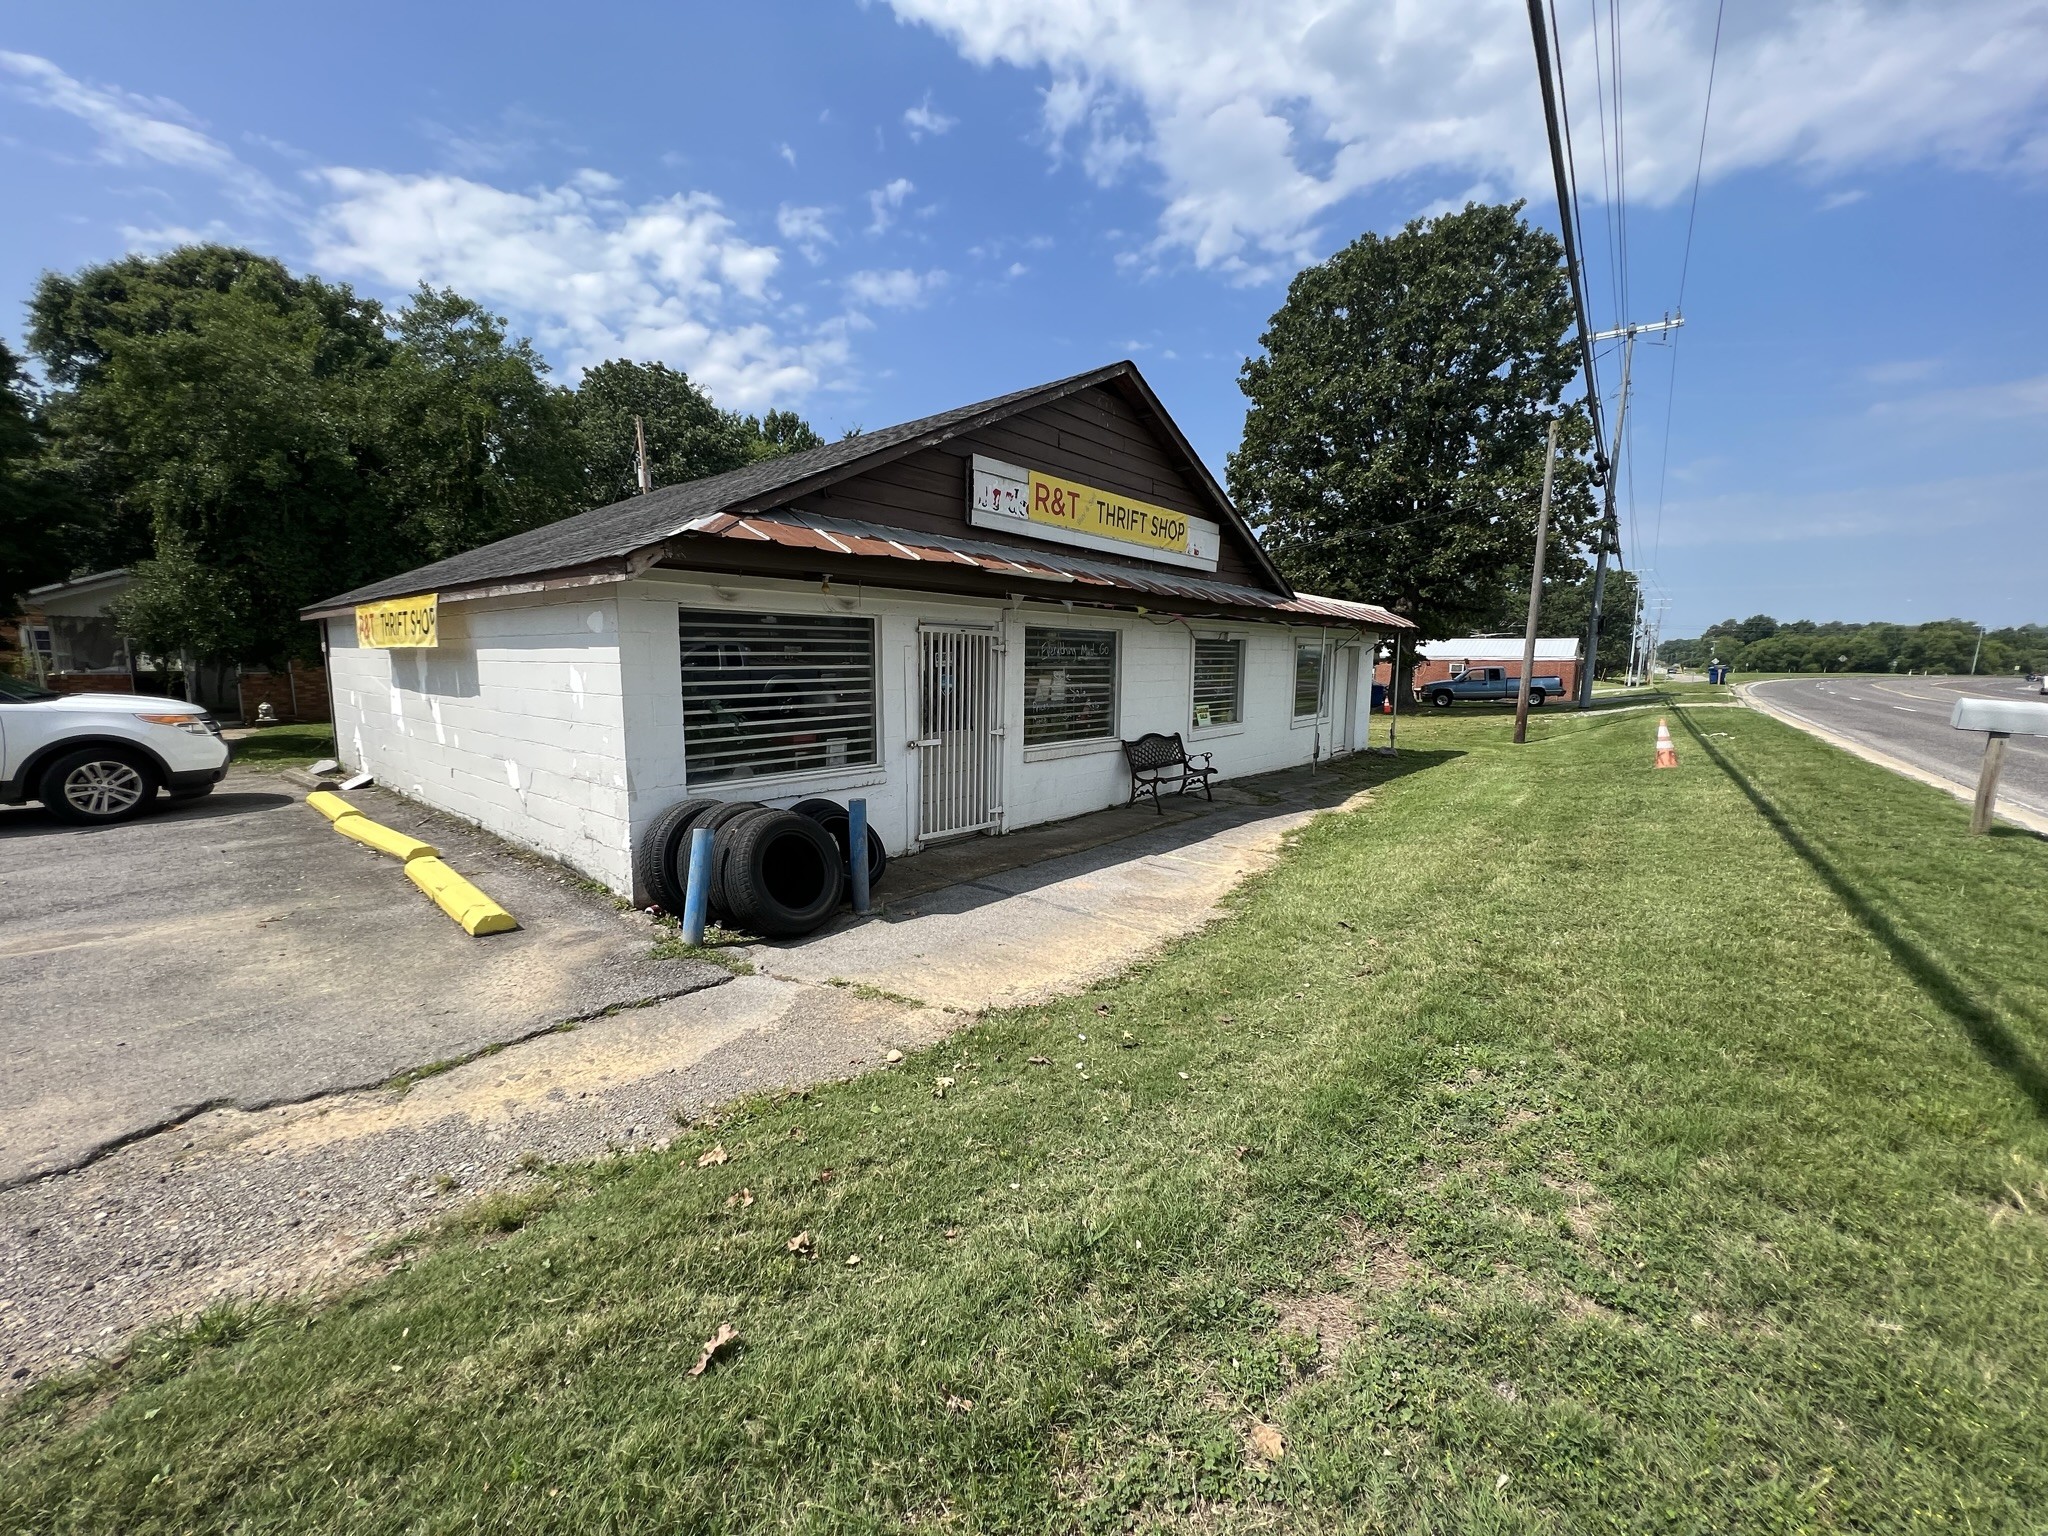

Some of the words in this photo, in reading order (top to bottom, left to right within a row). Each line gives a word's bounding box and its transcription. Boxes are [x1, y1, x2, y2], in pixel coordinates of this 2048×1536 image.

[1035, 482, 1080, 519] R&T
[1097, 500, 1147, 533] THRIFT
[1150, 516, 1185, 541] SHOP
[380, 611, 408, 636] THRIFT
[410, 607, 434, 635] SHOP
